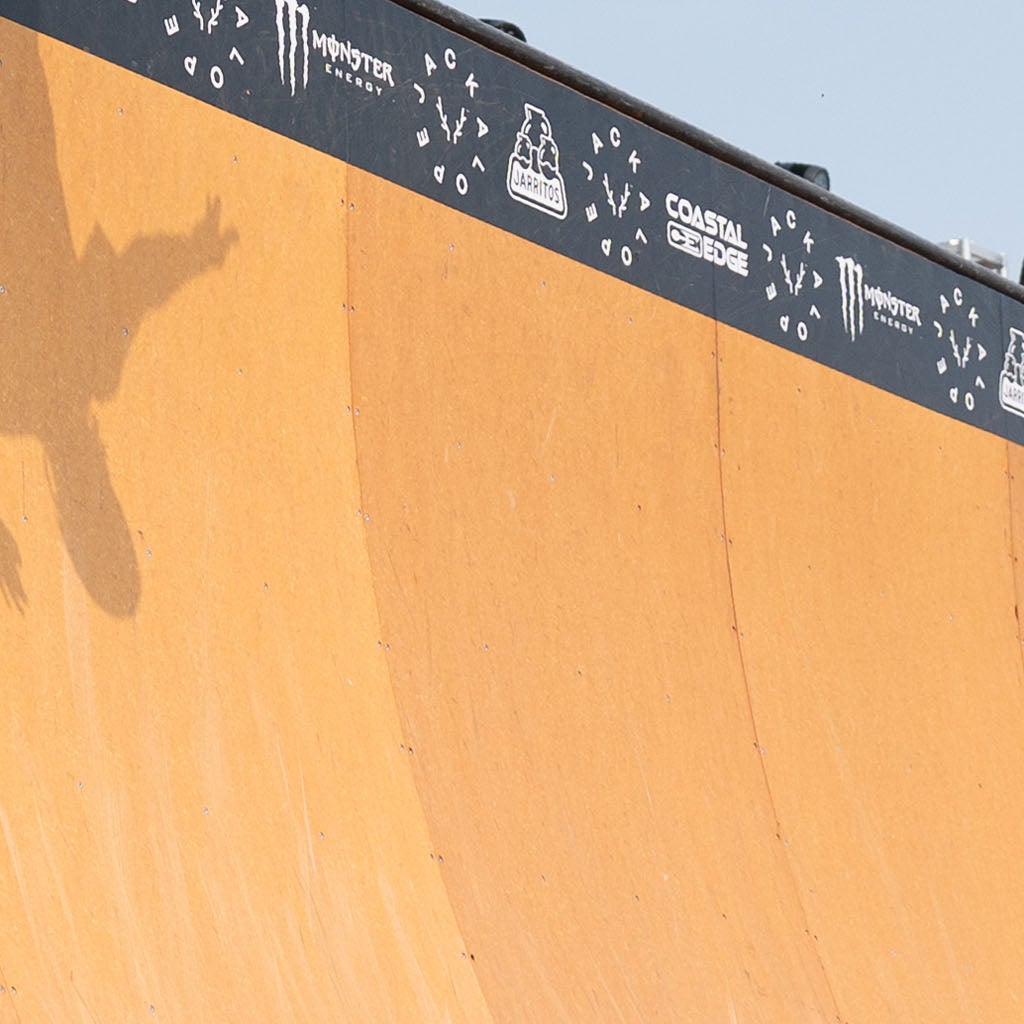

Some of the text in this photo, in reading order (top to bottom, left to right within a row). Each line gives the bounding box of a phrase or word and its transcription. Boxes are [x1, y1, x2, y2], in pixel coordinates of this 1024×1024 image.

[325, 63, 383, 96] ENERGY
[513, 168, 561, 205] JARRITOS
[665, 193, 748, 250] COASTAL
[703, 238, 749, 277] EDGE
[873, 312, 914, 335] ENERGY
